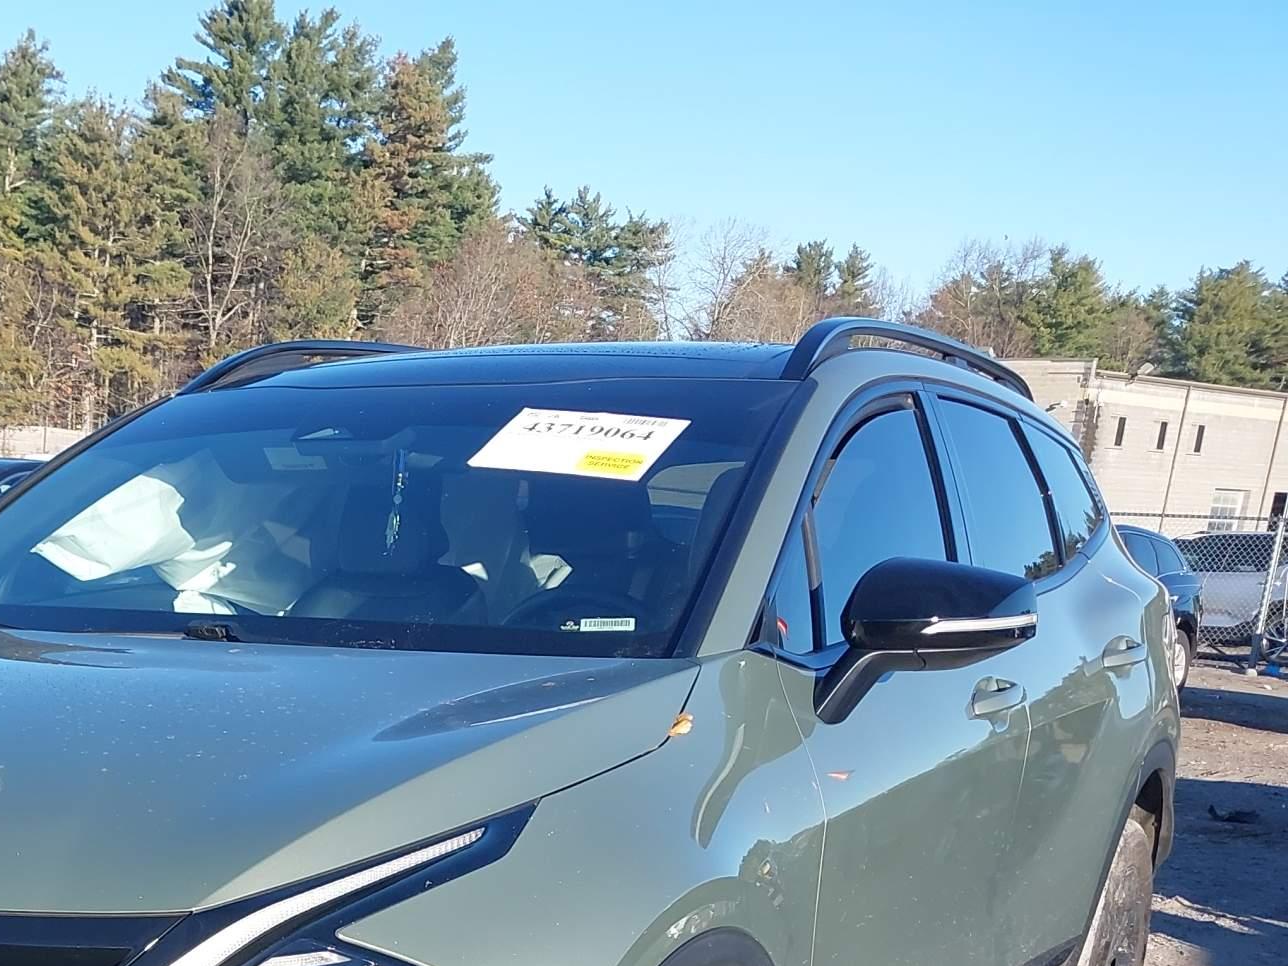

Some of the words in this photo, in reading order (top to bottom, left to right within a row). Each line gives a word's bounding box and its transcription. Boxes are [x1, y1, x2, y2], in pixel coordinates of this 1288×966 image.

[524, 421, 655, 442] 43719064
[585, 453, 644, 466] INSPECTION
[587, 460, 632, 470] SERVICE
